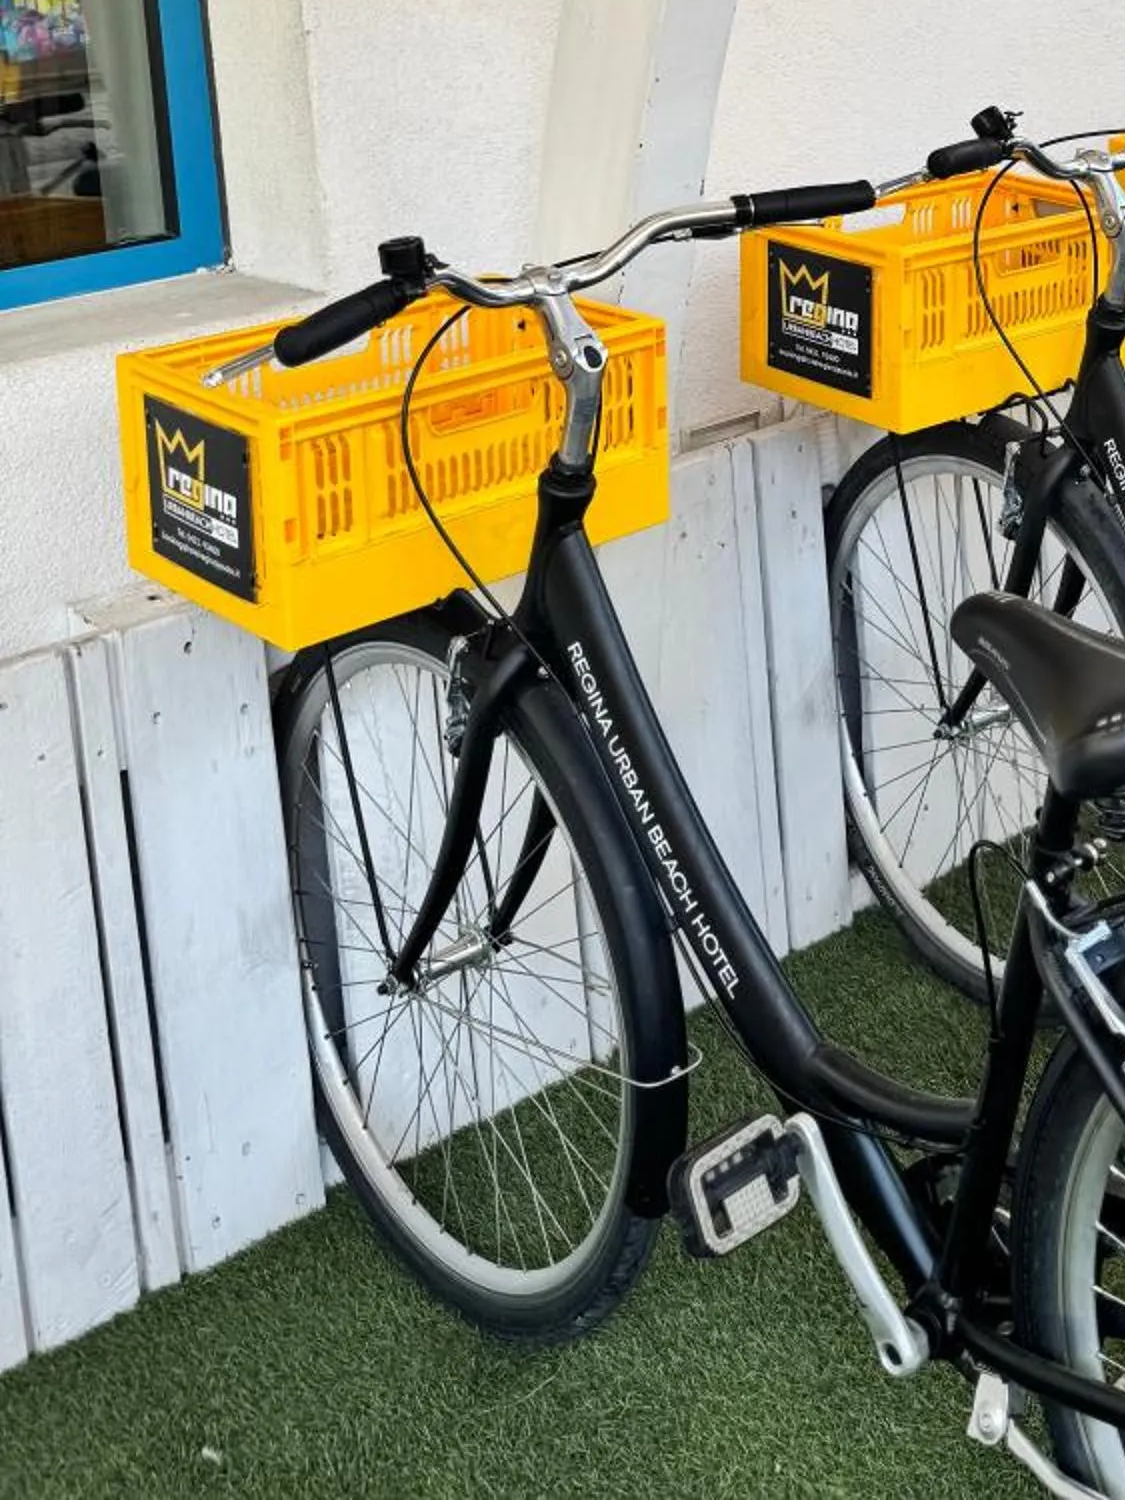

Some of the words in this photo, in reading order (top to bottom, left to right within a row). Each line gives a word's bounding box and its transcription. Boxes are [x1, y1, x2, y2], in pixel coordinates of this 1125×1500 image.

[789, 295, 859, 332] regina
[167, 466, 238, 519] regina
[567, 641, 613, 738] REGINA
[607, 734, 656, 825] URBAN
[647, 824, 699, 913] BEACH
[691, 912, 740, 1000] HOTEL
